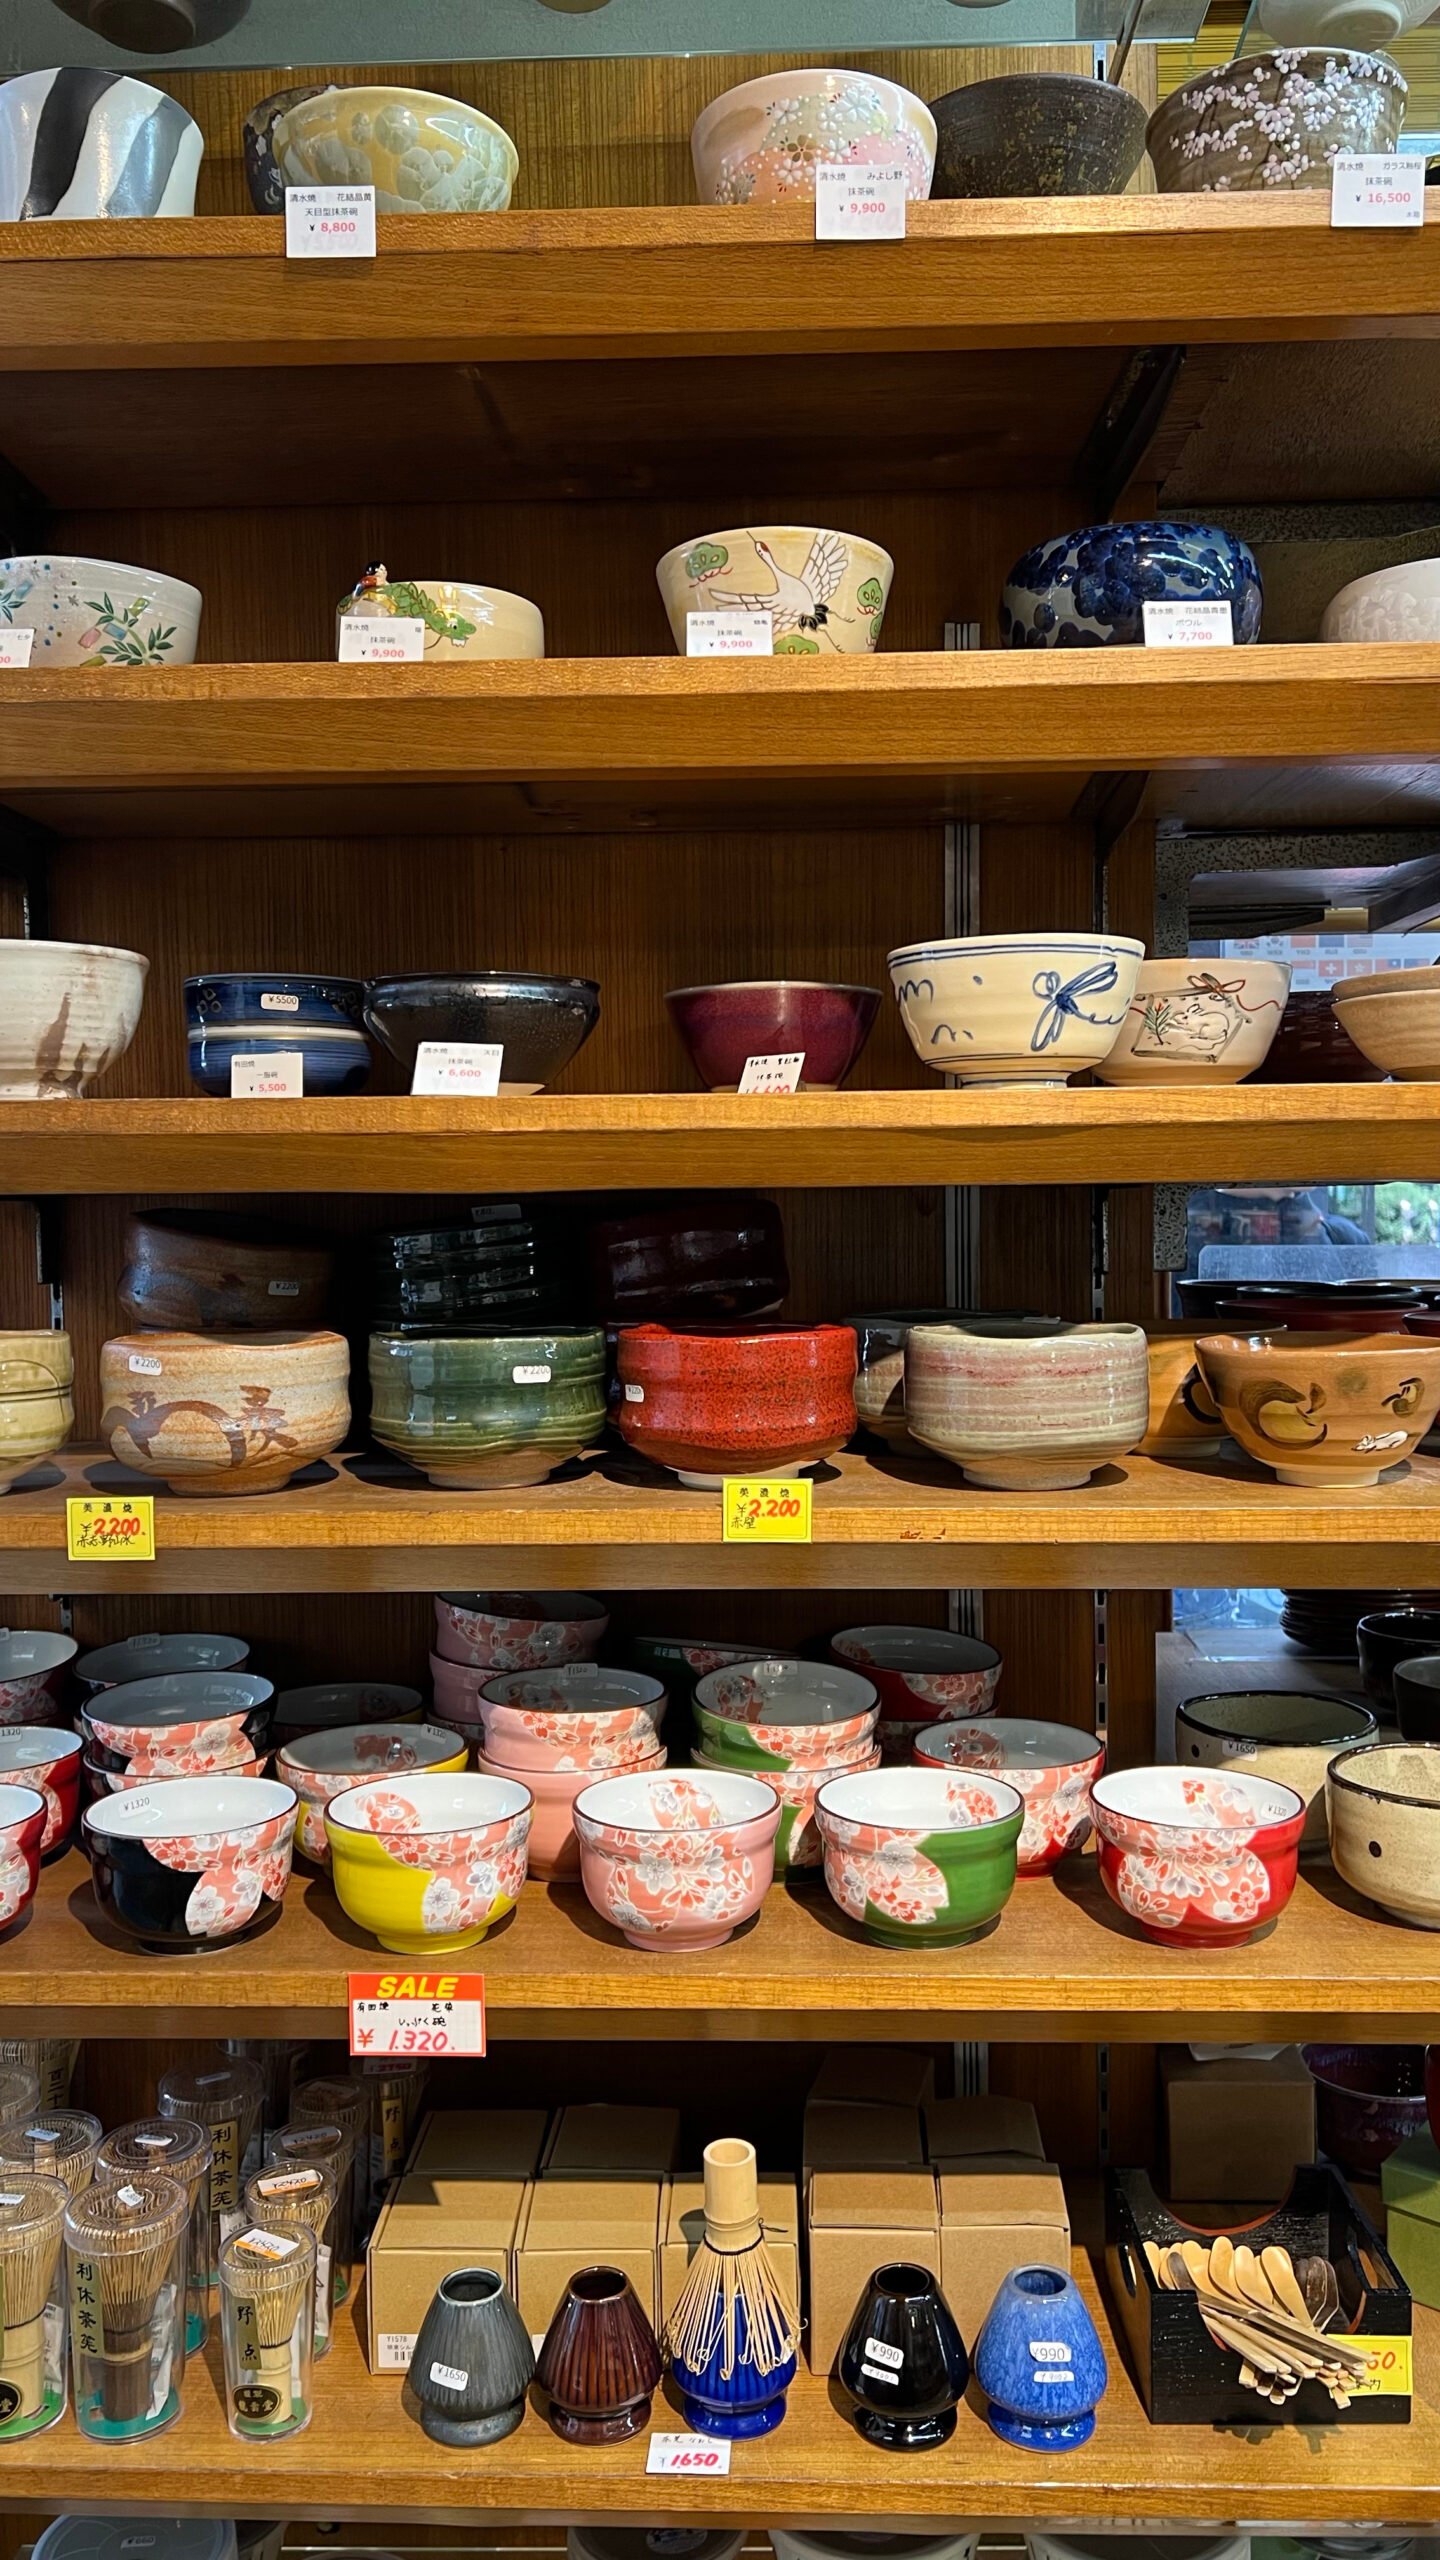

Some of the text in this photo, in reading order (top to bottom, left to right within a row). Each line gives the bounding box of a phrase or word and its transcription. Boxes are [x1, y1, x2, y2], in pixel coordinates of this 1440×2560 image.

[1368, 192, 1411, 204] 16,500
[850, 202, 885, 214] 9,900
[321, 222, 356, 234] 8,800
[1179, 632, 1212, 642] 7,700
[720, 640, 753, 648] 9,900
[372, 649, 405, 658] 9,900
[449, 1069, 482, 1078] 6,600
[259, 1083, 286, 1093] 5,500
[135, 1357, 160, 1368] ¥2200
[376, 1976, 459, 1999] SALE
[872, 2341, 900, 2362] ¥990
[1033, 2347, 1065, 2361] ¥990
[439, 2365, 467, 2382] ¥1650
